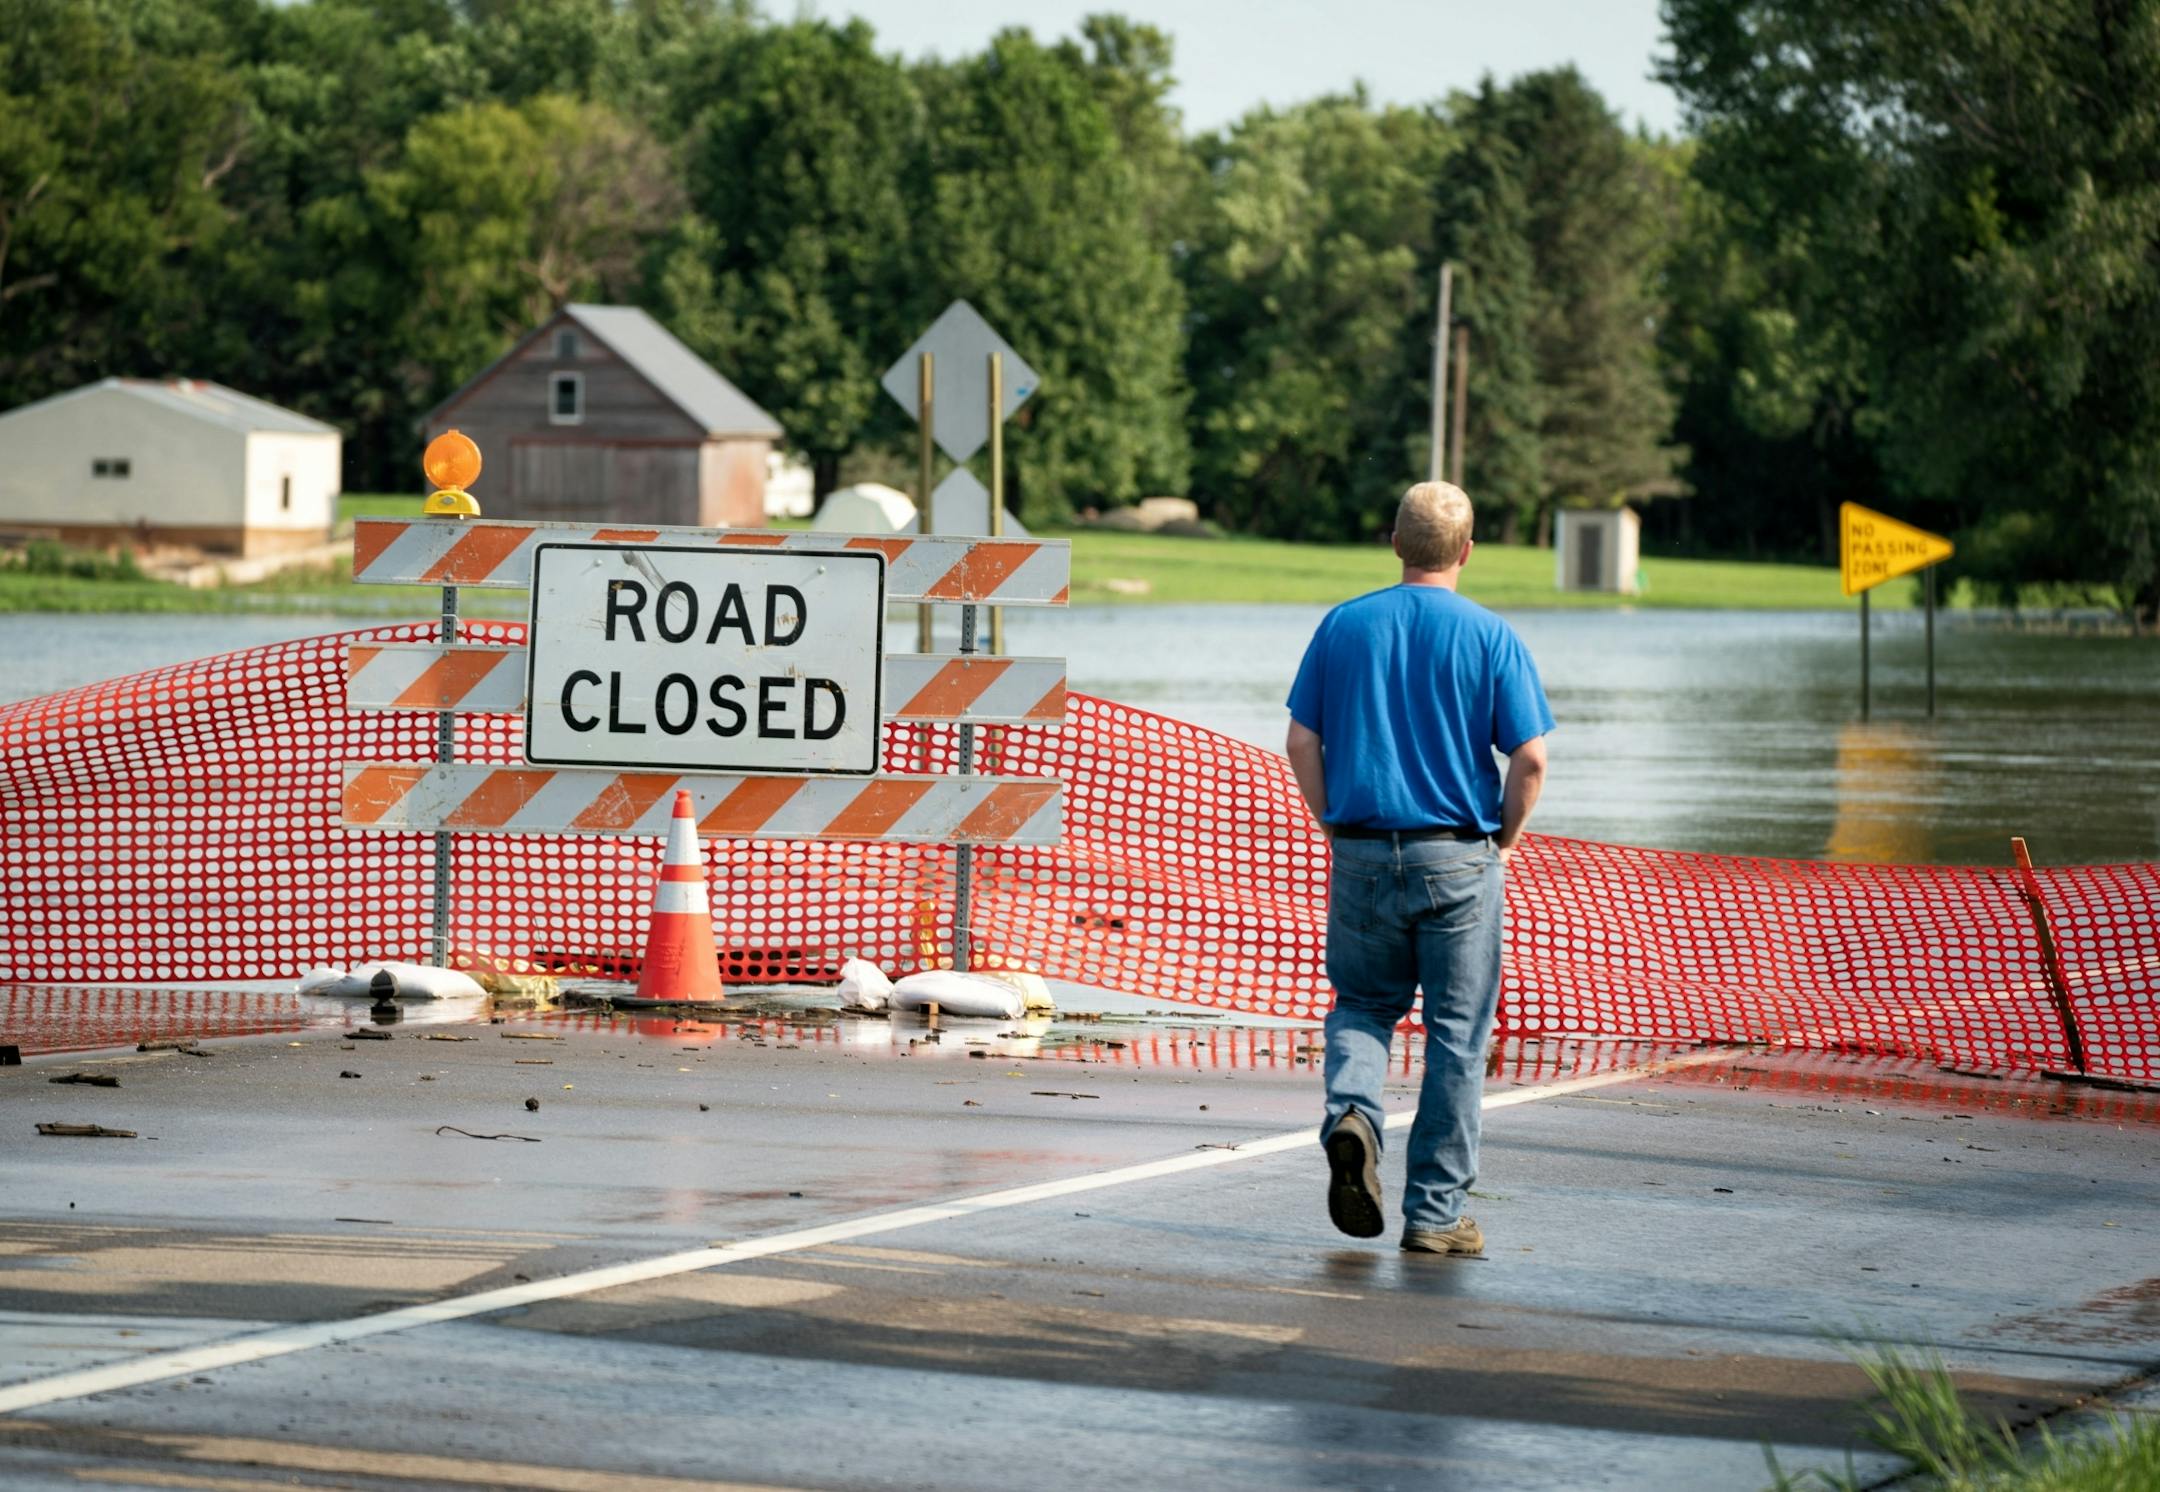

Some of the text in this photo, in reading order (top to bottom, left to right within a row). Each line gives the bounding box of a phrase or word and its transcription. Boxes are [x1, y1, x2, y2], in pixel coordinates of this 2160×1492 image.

[1852, 523, 1874, 537] NO
[1852, 542, 1927, 555] PASSING
[1853, 562, 1888, 576] ZONE
[605, 579, 807, 646] ROAD
[561, 670, 847, 740] CLOSED
